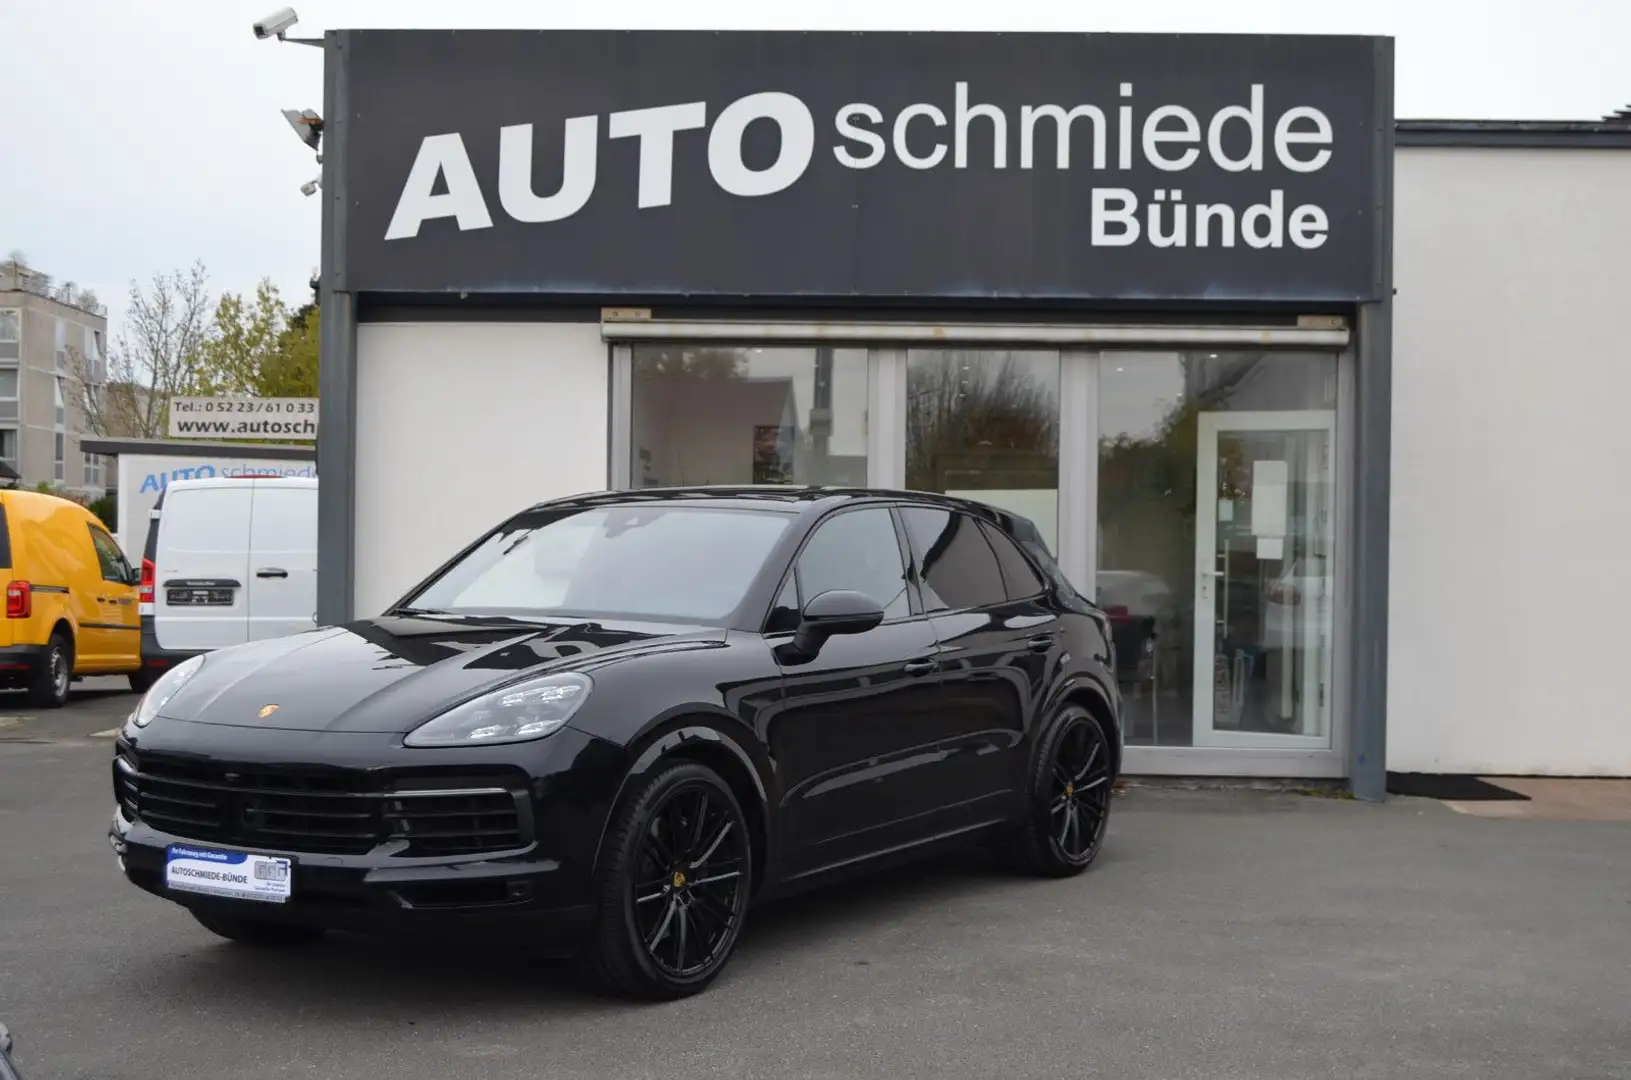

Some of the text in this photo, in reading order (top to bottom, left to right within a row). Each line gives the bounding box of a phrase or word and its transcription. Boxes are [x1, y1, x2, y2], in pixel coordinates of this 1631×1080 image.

[384, 81, 1334, 241] AUTO schmiede
[1091, 187, 1330, 250] Bünde
[171, 866, 248, 884] AUTOSCHMIEDE-BÜNDE
